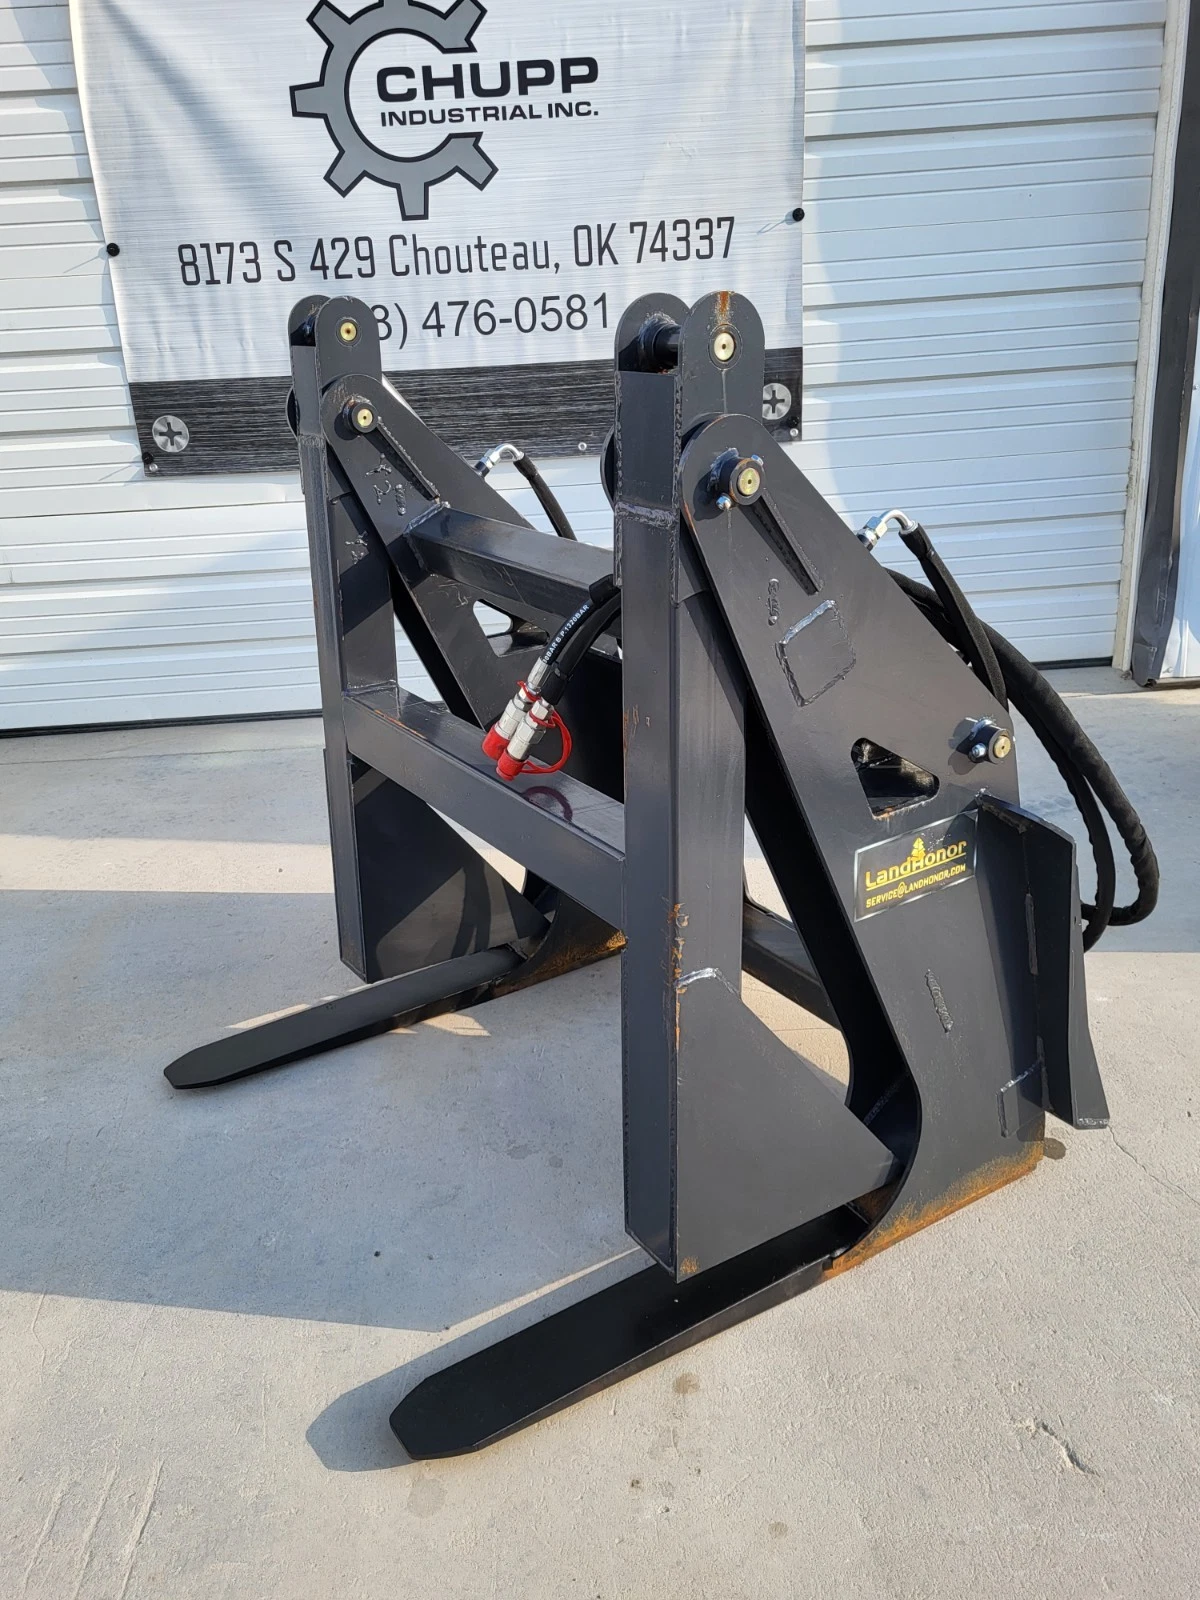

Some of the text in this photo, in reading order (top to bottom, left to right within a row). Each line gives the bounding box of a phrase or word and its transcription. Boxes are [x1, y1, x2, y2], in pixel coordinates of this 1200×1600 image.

[376, 56, 598, 103] CHUPP
[381, 101, 599, 127] INDUSTRIAL INC.
[177, 216, 735, 286] 8173 S 429 Chouteau, OK 74337
[421, 292, 609, 338] 476-0581
[865, 840, 967, 889] LandHonor
[866, 863, 966, 908] SERVICE@LANDHONOR.COM
